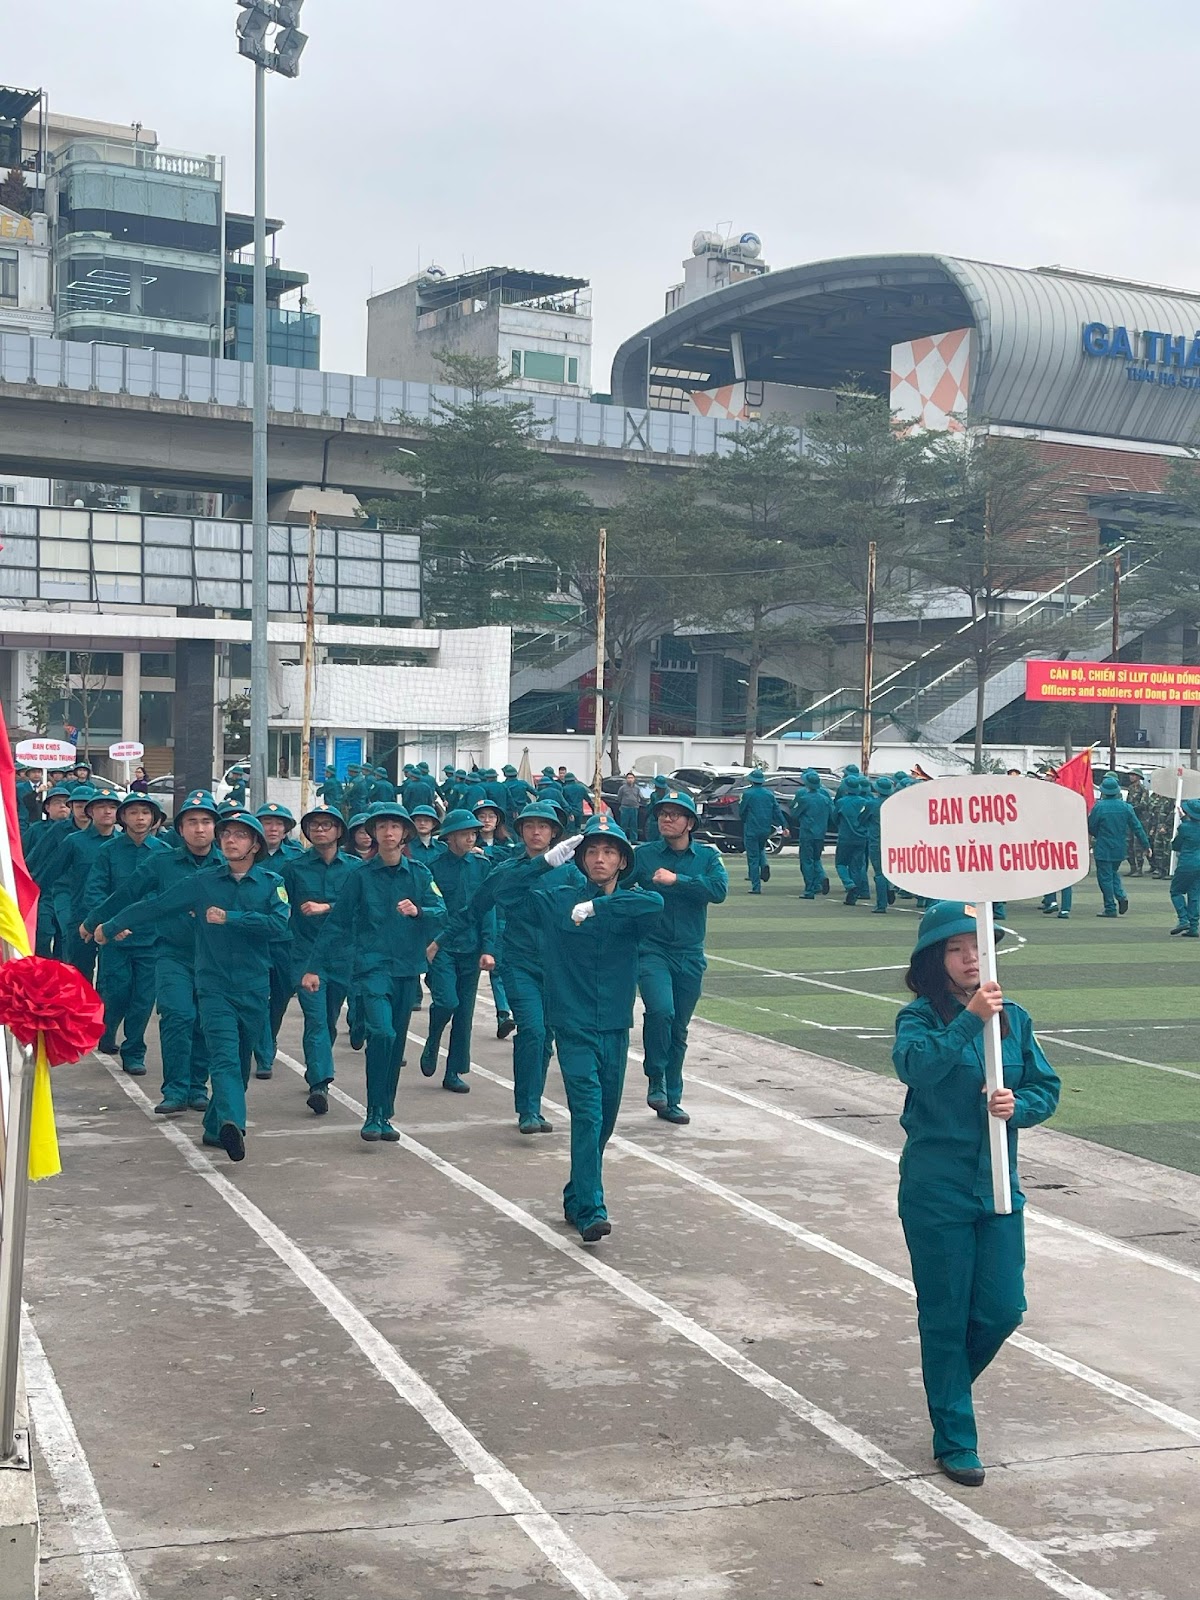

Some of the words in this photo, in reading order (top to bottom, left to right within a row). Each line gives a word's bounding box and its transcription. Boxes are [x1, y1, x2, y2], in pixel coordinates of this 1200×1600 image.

[1083, 321, 1133, 361] GA
[1050, 667, 1069, 680] CÁN
[1071, 667, 1086, 682] BỘ,
[1088, 667, 1116, 682] CHIẾN
[1118, 669, 1127, 683] SĨ
[1129, 671, 1149, 683] LLVT
[1150, 670, 1175, 686] QUẬN
[1041, 684, 1076, 697] Officers
[1078, 686, 1095, 697] and
[1096, 686, 1132, 698] soldiers
[1134, 687, 1144, 699] of
[1145, 688, 1167, 702] Dong
[1169, 688, 1181, 700] Da
[928, 797, 963, 825] BAN
[968, 794, 1018, 826] CHQS
[888, 839, 951, 874] PHƯỜNG
[955, 839, 994, 872] VĂN
[999, 839, 1079, 871] CHƯƠNG
